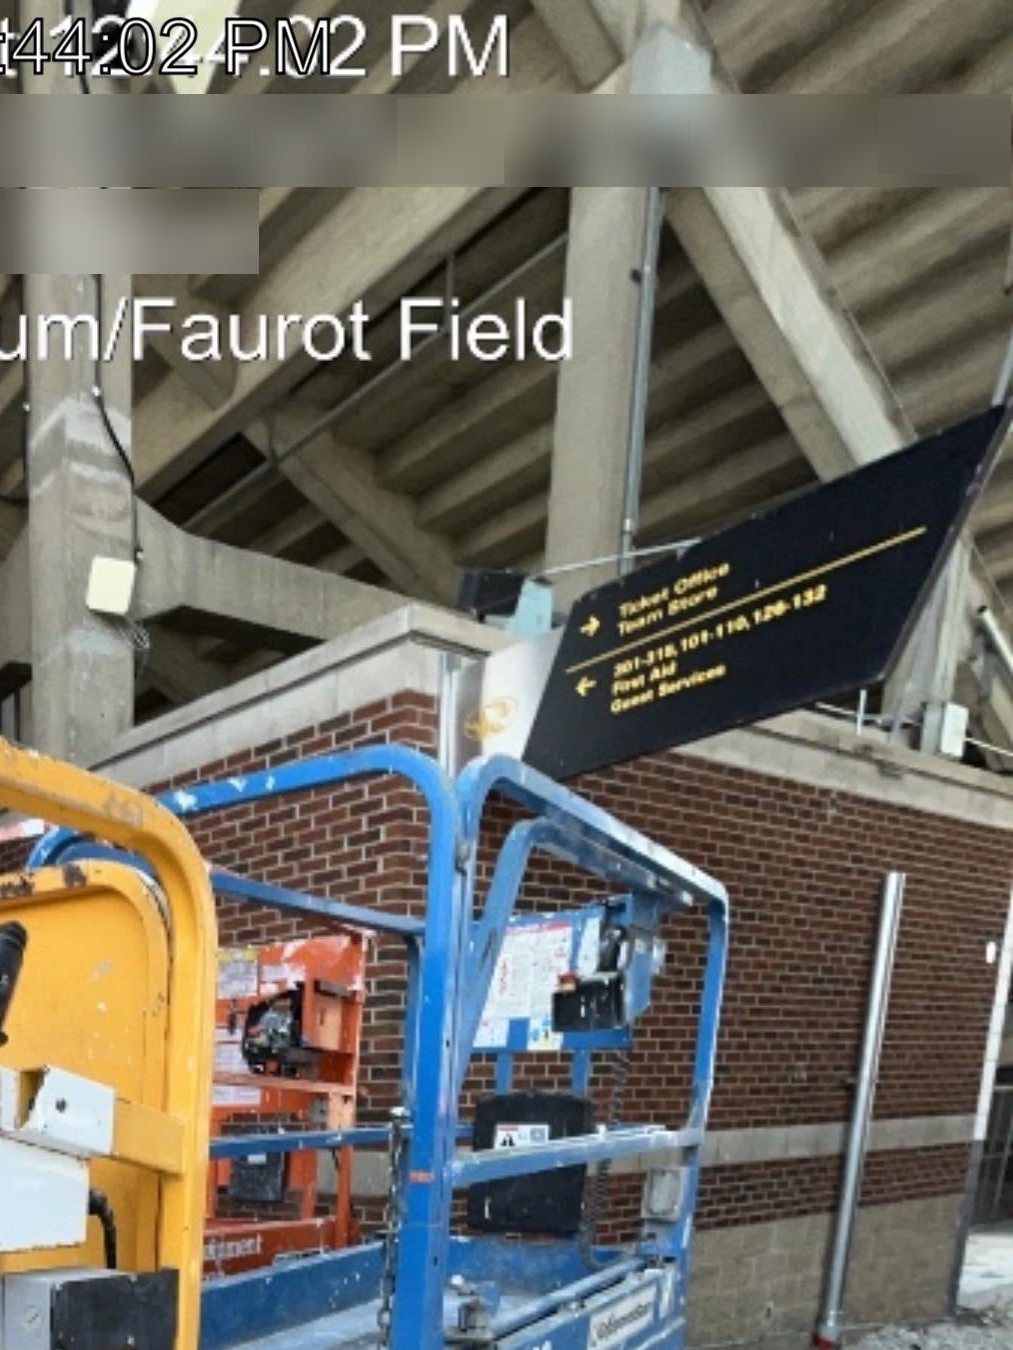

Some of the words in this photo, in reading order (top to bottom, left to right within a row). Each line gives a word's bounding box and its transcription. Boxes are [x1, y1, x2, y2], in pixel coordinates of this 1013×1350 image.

[617, 586, 669, 619] Ticket
[673, 562, 730, 595] Office
[616, 610, 664, 637] Team
